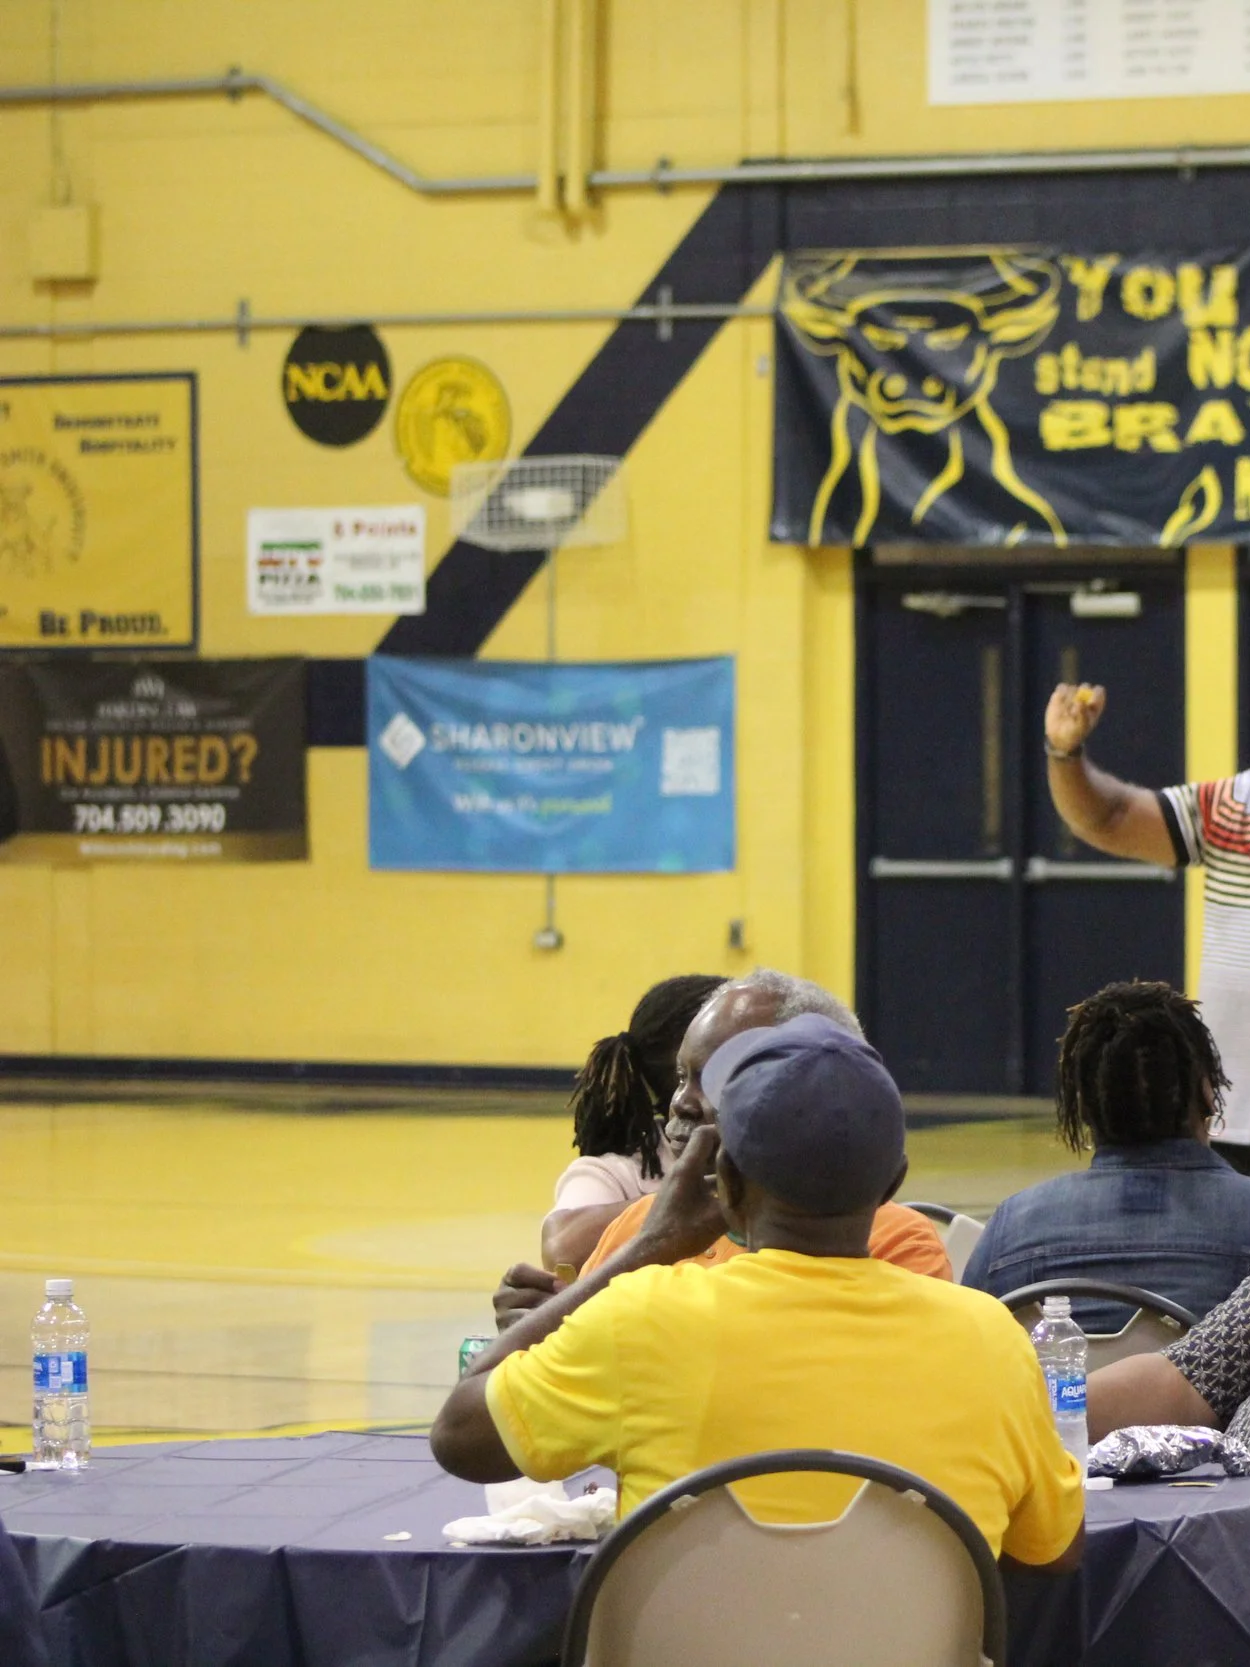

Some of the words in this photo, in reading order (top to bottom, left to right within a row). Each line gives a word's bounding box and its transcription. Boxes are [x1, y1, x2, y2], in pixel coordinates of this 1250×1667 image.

[1058, 252, 1239, 329] YOU
[286, 361, 388, 402] NCAA
[1035, 341, 1157, 396] stand
[40, 732, 258, 785] INJURED?
[431, 722, 639, 753] SHARONVIEW
